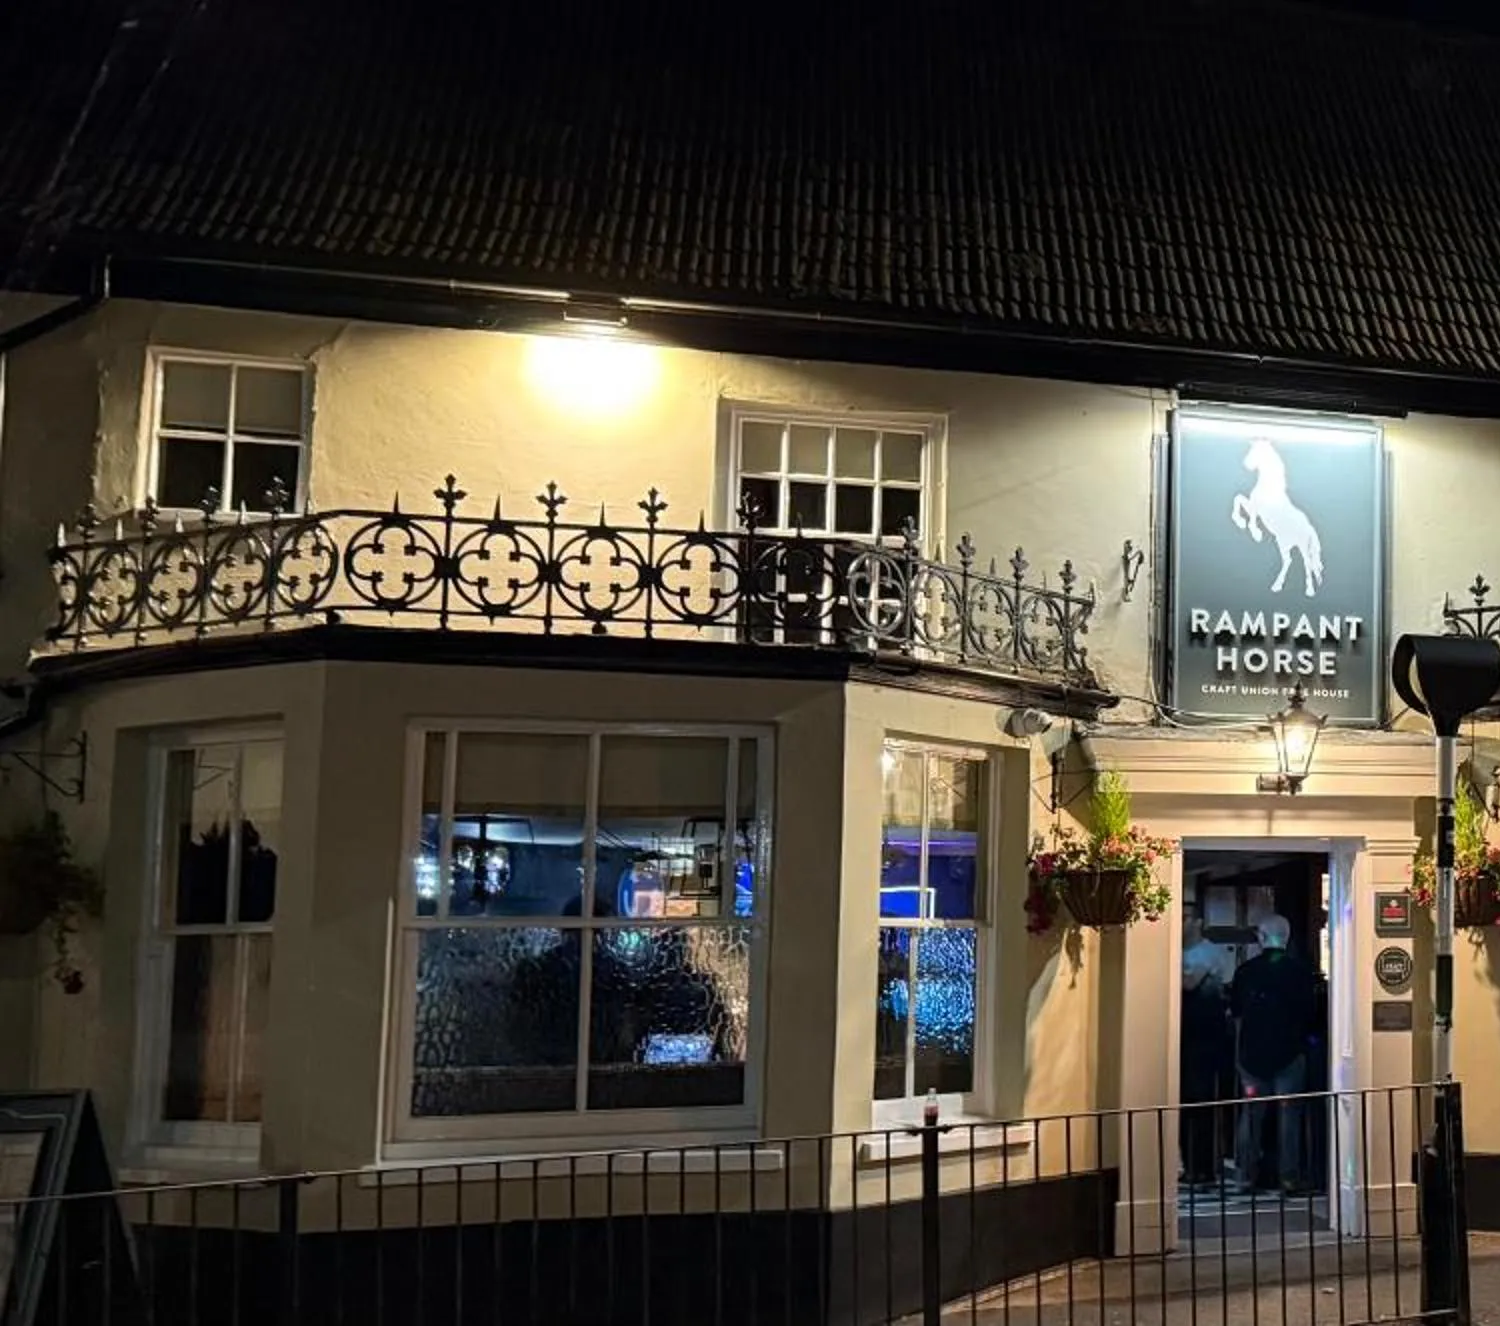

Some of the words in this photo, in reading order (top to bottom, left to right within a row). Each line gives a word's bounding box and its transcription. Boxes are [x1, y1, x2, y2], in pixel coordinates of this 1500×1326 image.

[1190, 608, 1363, 641] RAMPANT
[1216, 647, 1337, 675] HORSE
[1201, 684, 1237, 694] CRAFT
[1241, 686, 1279, 696] UNION
[1282, 687, 1309, 697] FRE
[1313, 688, 1350, 698] HOUSE
